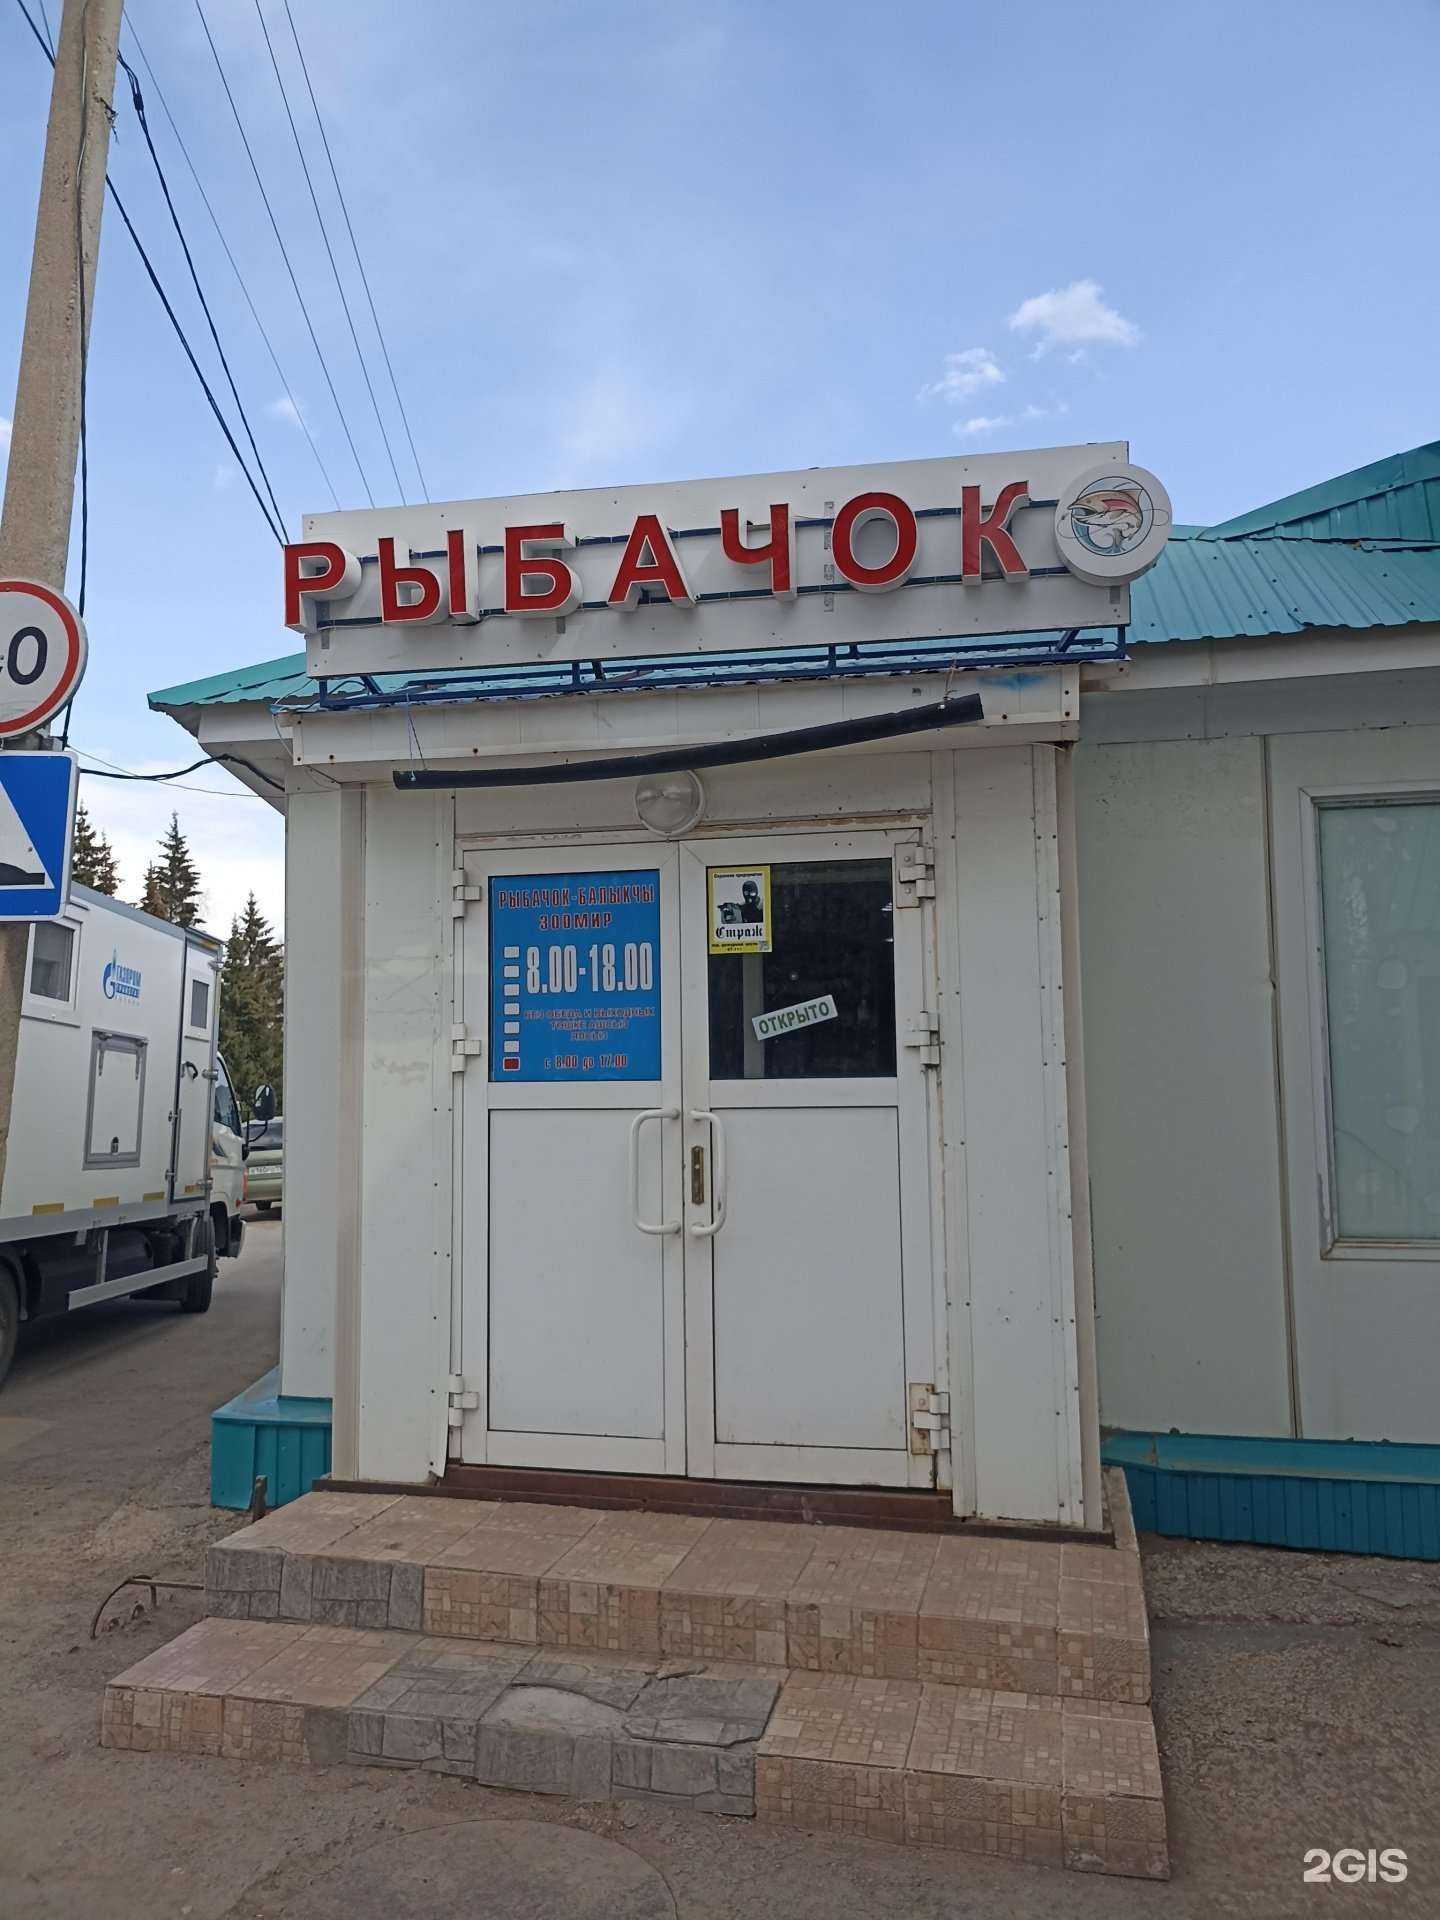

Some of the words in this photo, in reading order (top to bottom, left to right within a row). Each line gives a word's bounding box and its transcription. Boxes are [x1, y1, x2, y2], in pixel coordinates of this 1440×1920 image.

[285, 481, 1030, 632] РЫБАЧОК
[0, 626, 48, 685] 0
[539, 912, 613, 930] ЗООМИР
[715, 924, 763, 940] Страж
[526, 943, 653, 993] 8.00-18.00
[758, 1001, 830, 1035] ОТКРЫТО
